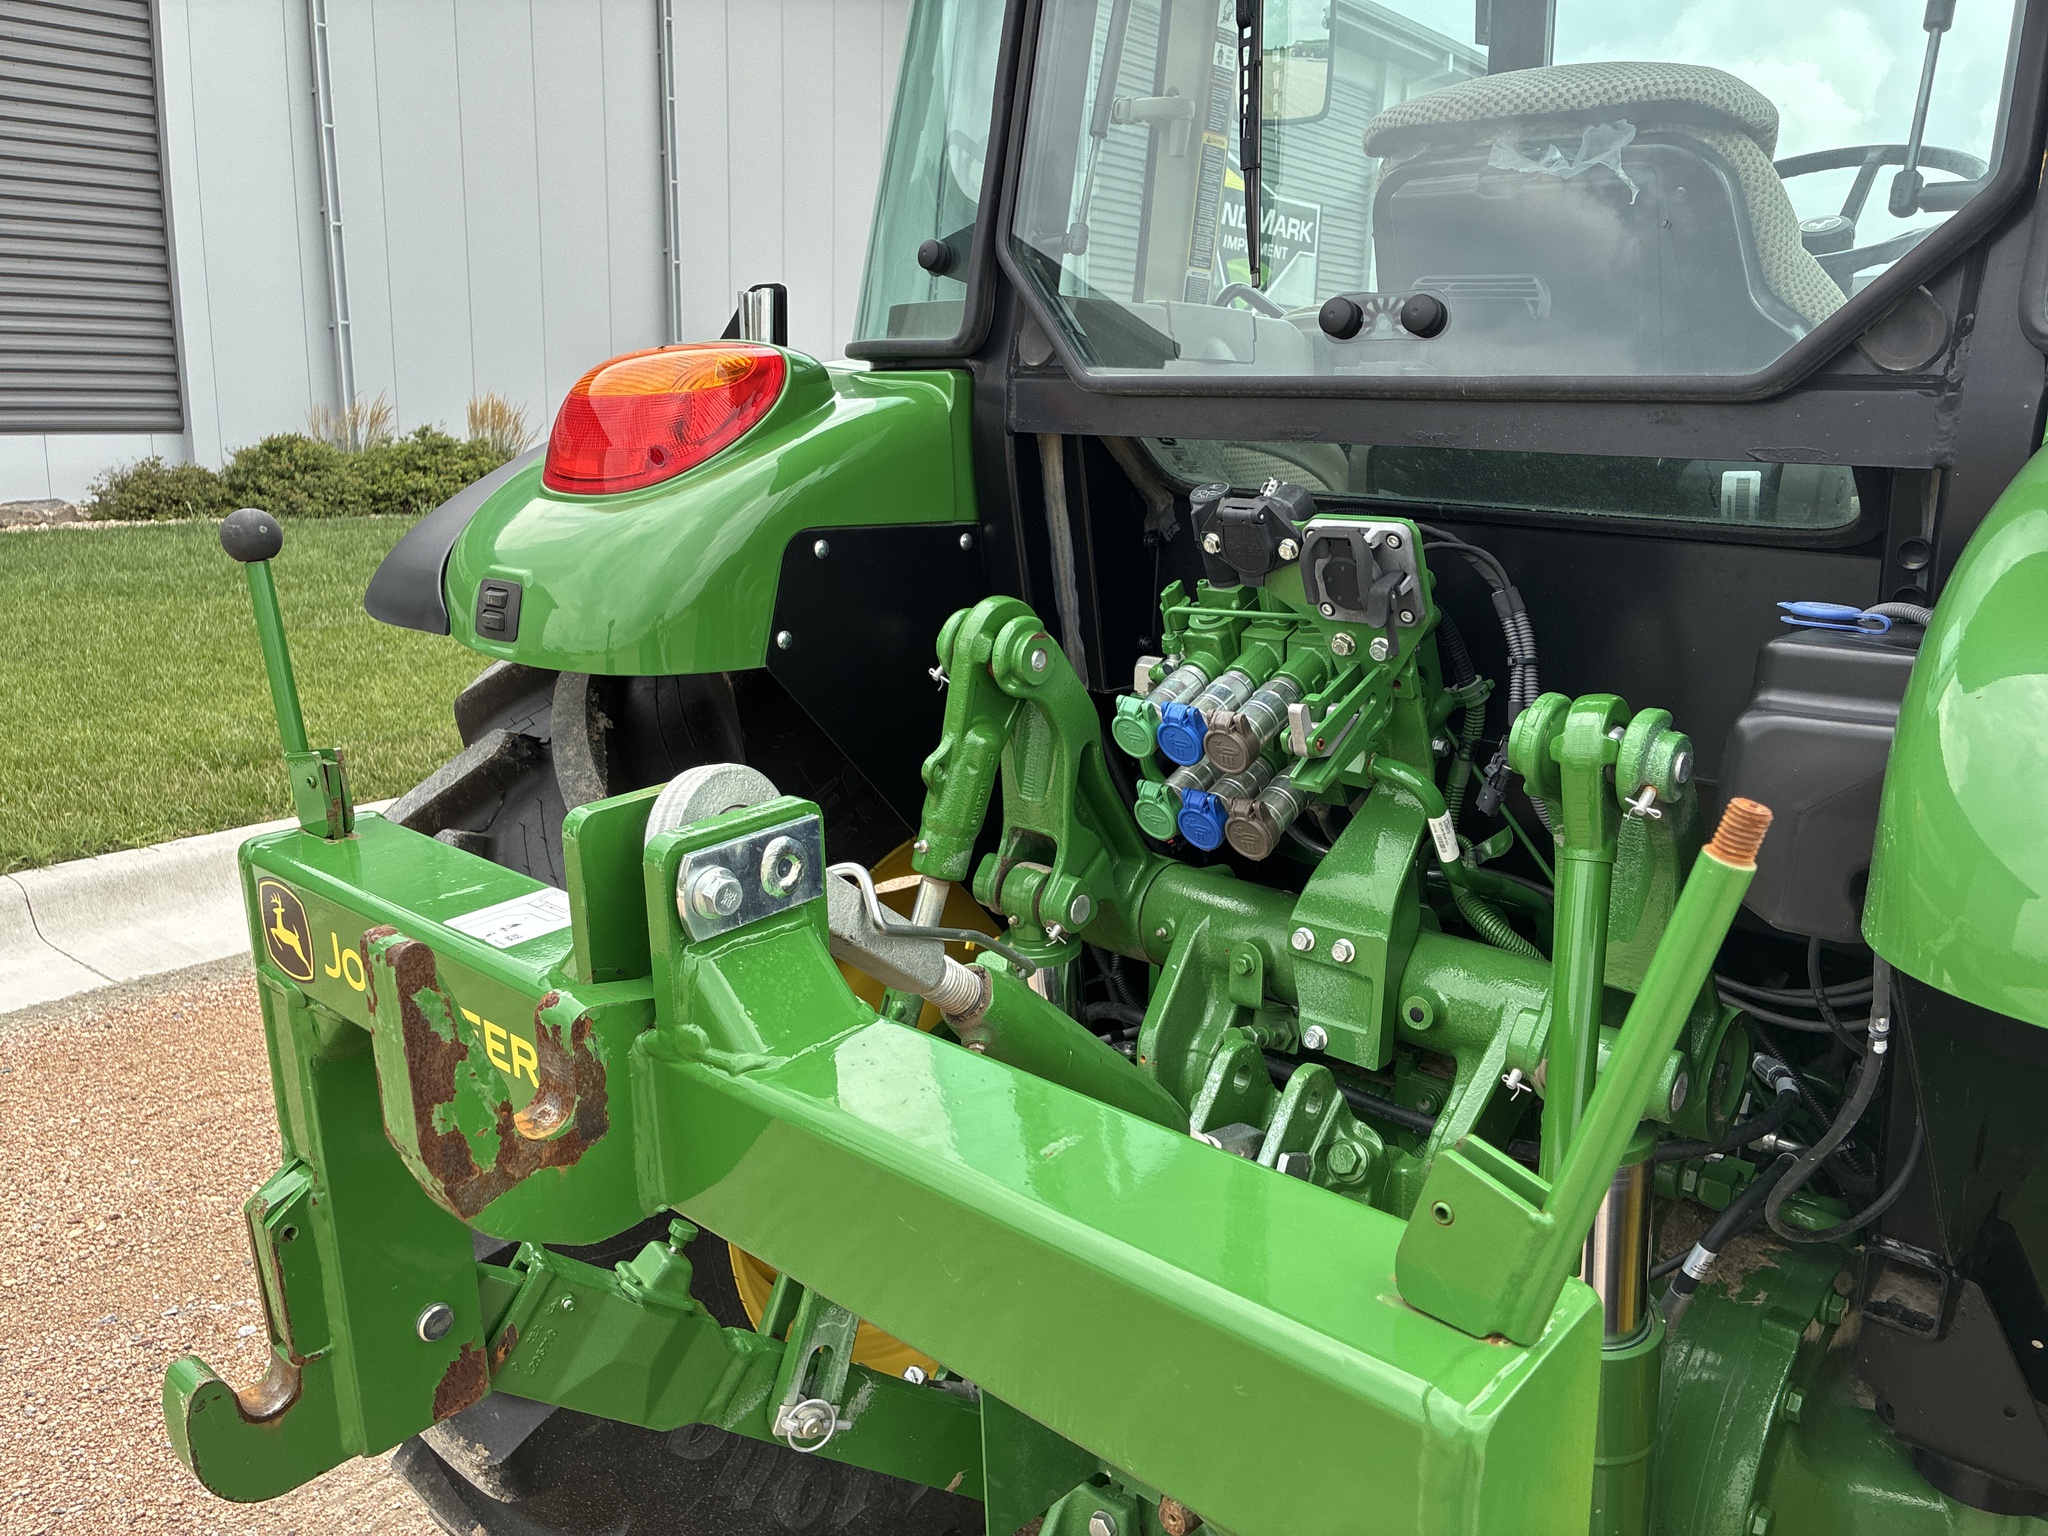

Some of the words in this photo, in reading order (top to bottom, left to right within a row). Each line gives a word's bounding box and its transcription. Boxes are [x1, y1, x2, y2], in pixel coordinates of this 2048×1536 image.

[1220, 201, 1314, 244] NDMARK
[1222, 233, 1289, 260] IMPLMENT
[1226, 540, 1263, 557] Pollak
[325, 931, 367, 992] JO
